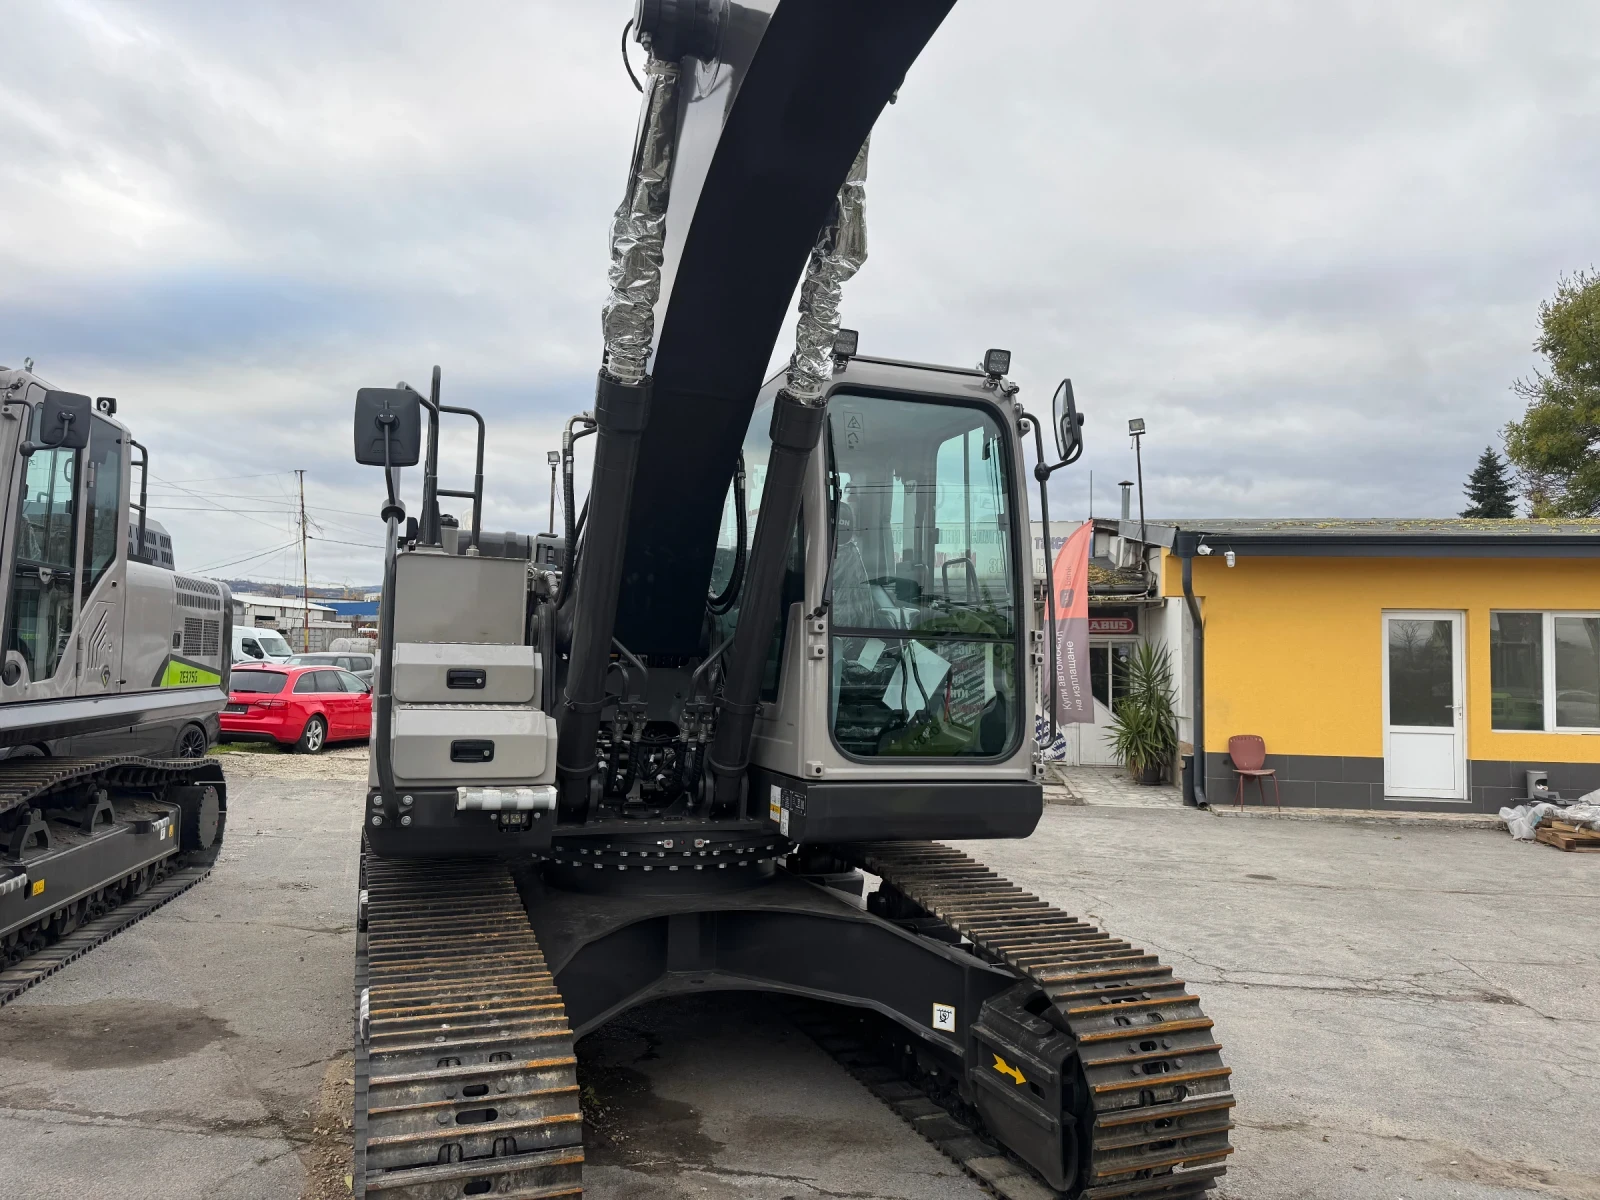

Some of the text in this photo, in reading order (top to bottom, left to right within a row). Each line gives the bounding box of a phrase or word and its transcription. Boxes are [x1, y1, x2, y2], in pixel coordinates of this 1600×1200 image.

[1090, 620, 1128, 630] ABUS
[179, 670, 198, 684] ZE375G
[1066, 640, 1083, 711] на изплащане
[1060, 688, 1073, 710] Купи
